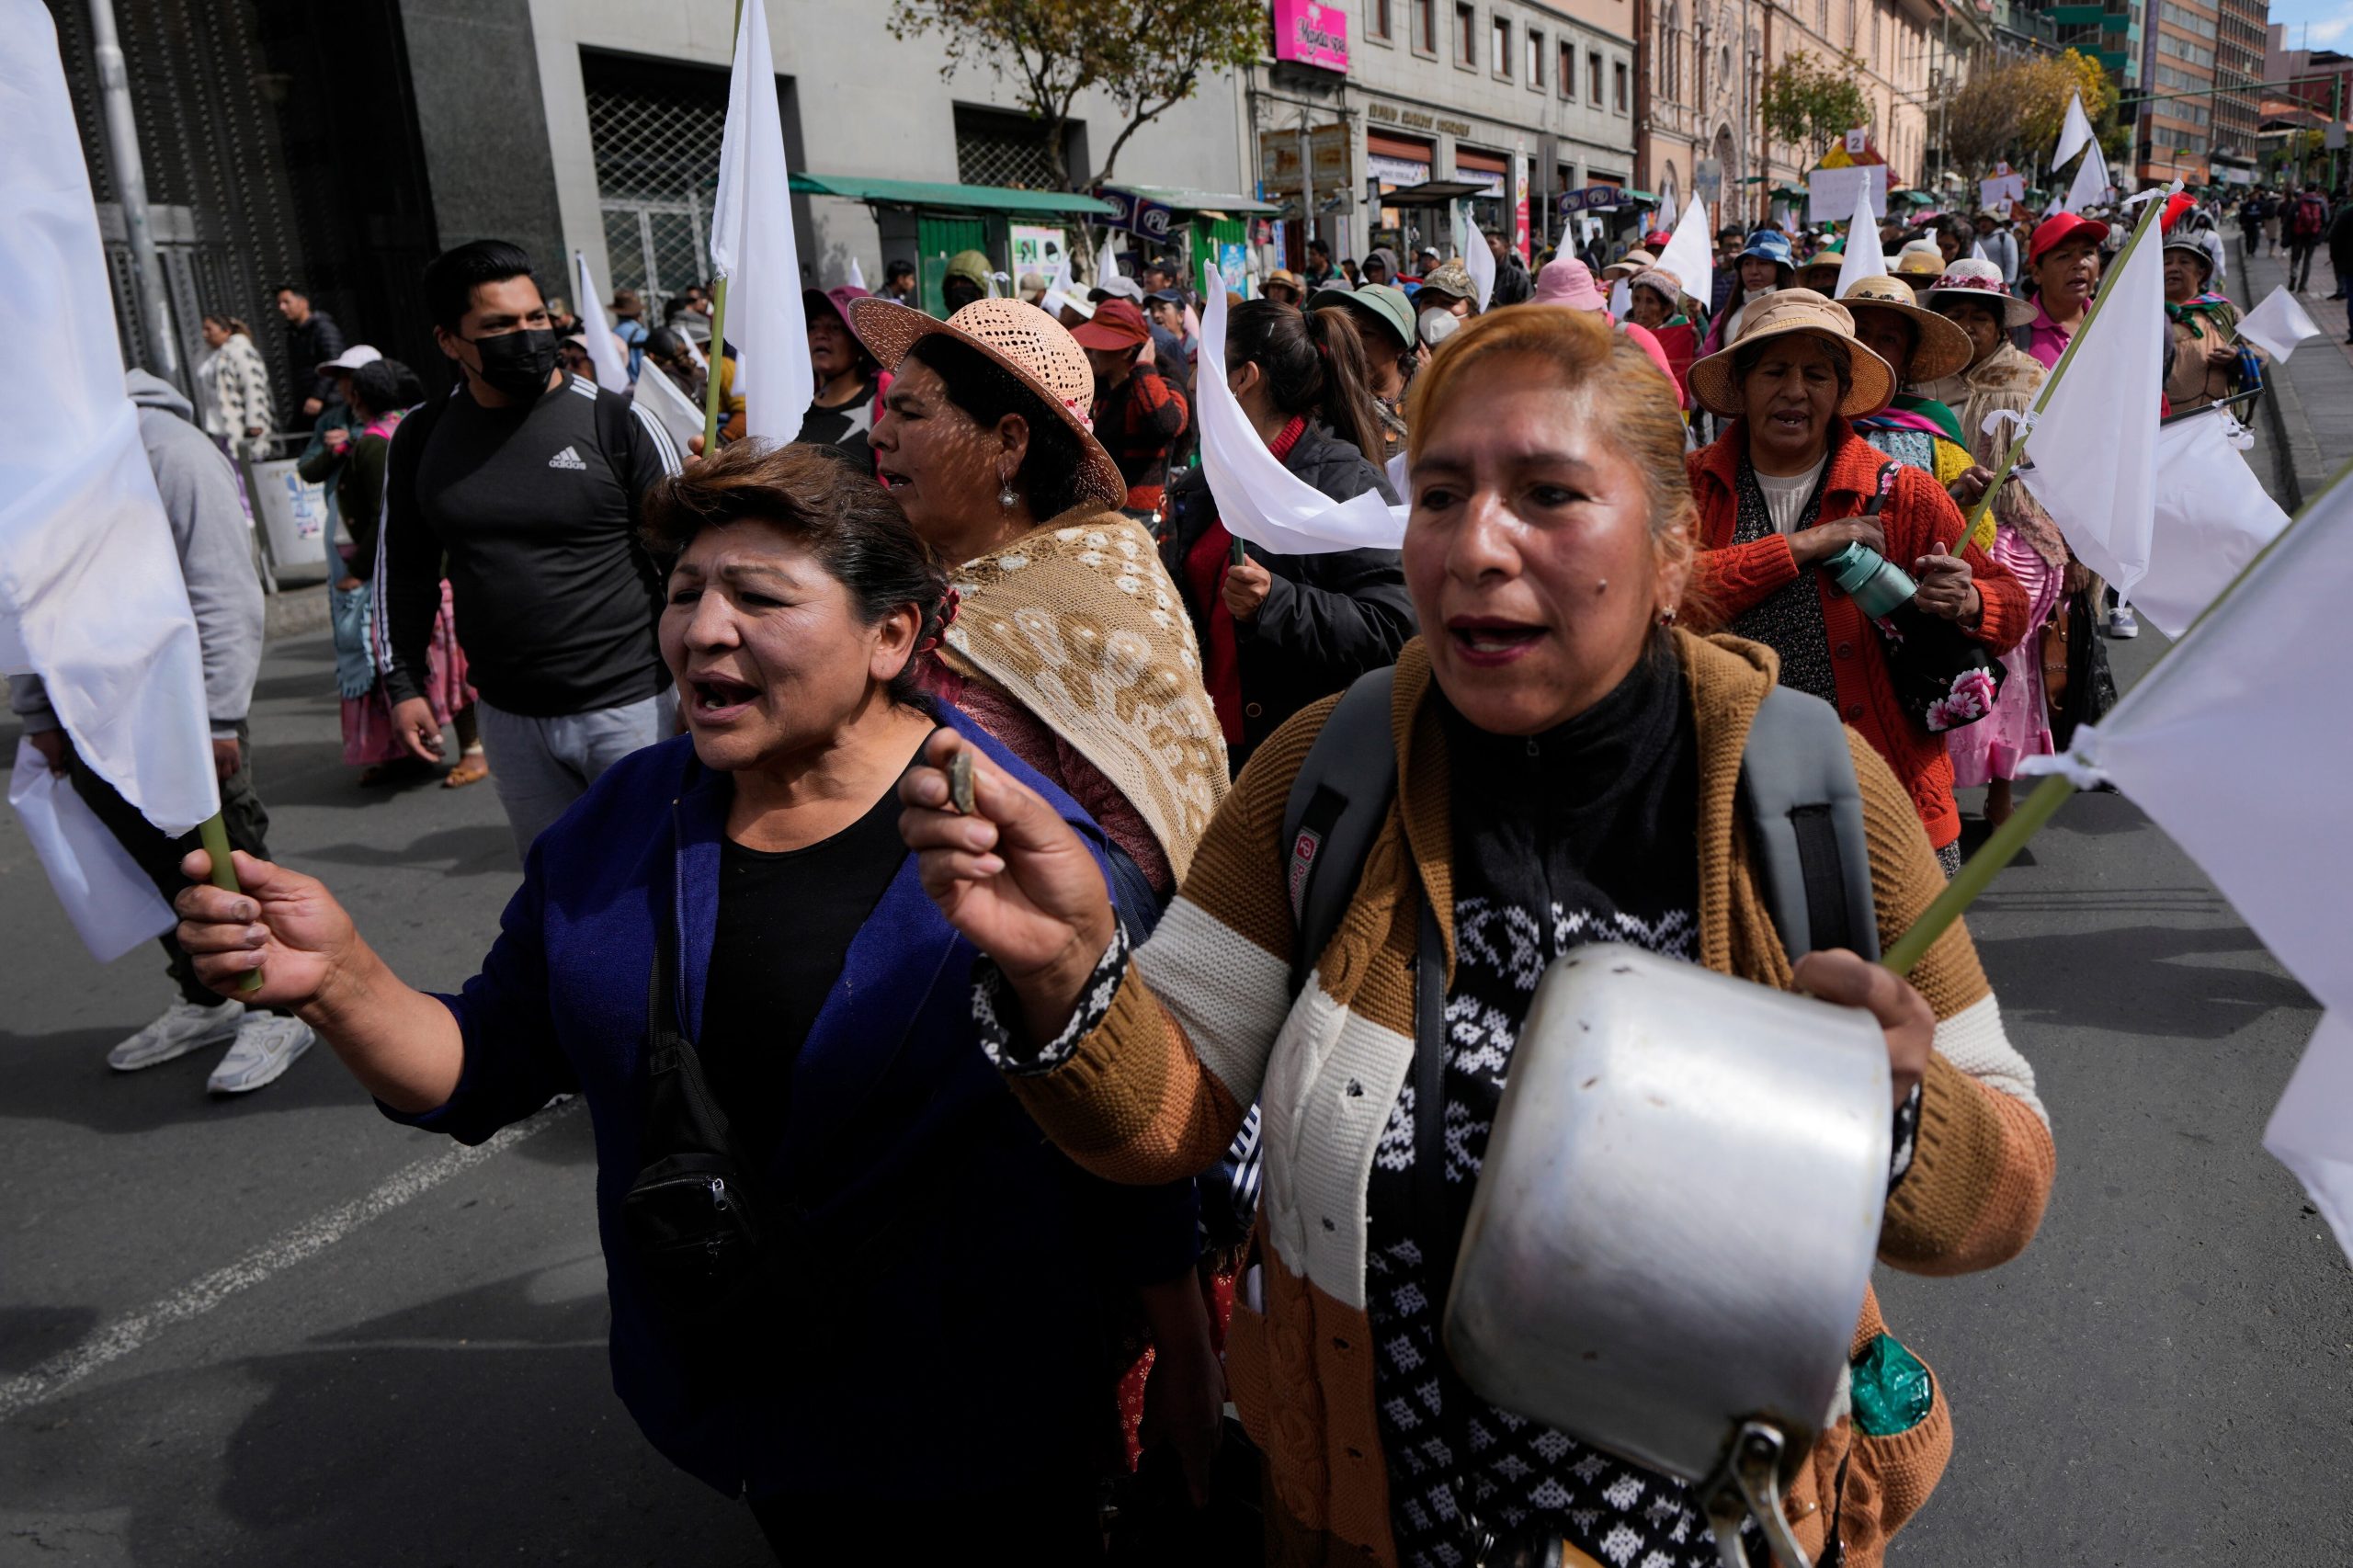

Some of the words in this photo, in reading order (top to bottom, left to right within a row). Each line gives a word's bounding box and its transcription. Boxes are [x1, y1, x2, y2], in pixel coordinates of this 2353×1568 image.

[1850, 137, 1860, 149] 2
[1148, 211, 1170, 233] Pil
[549, 460, 586, 470] adidas
